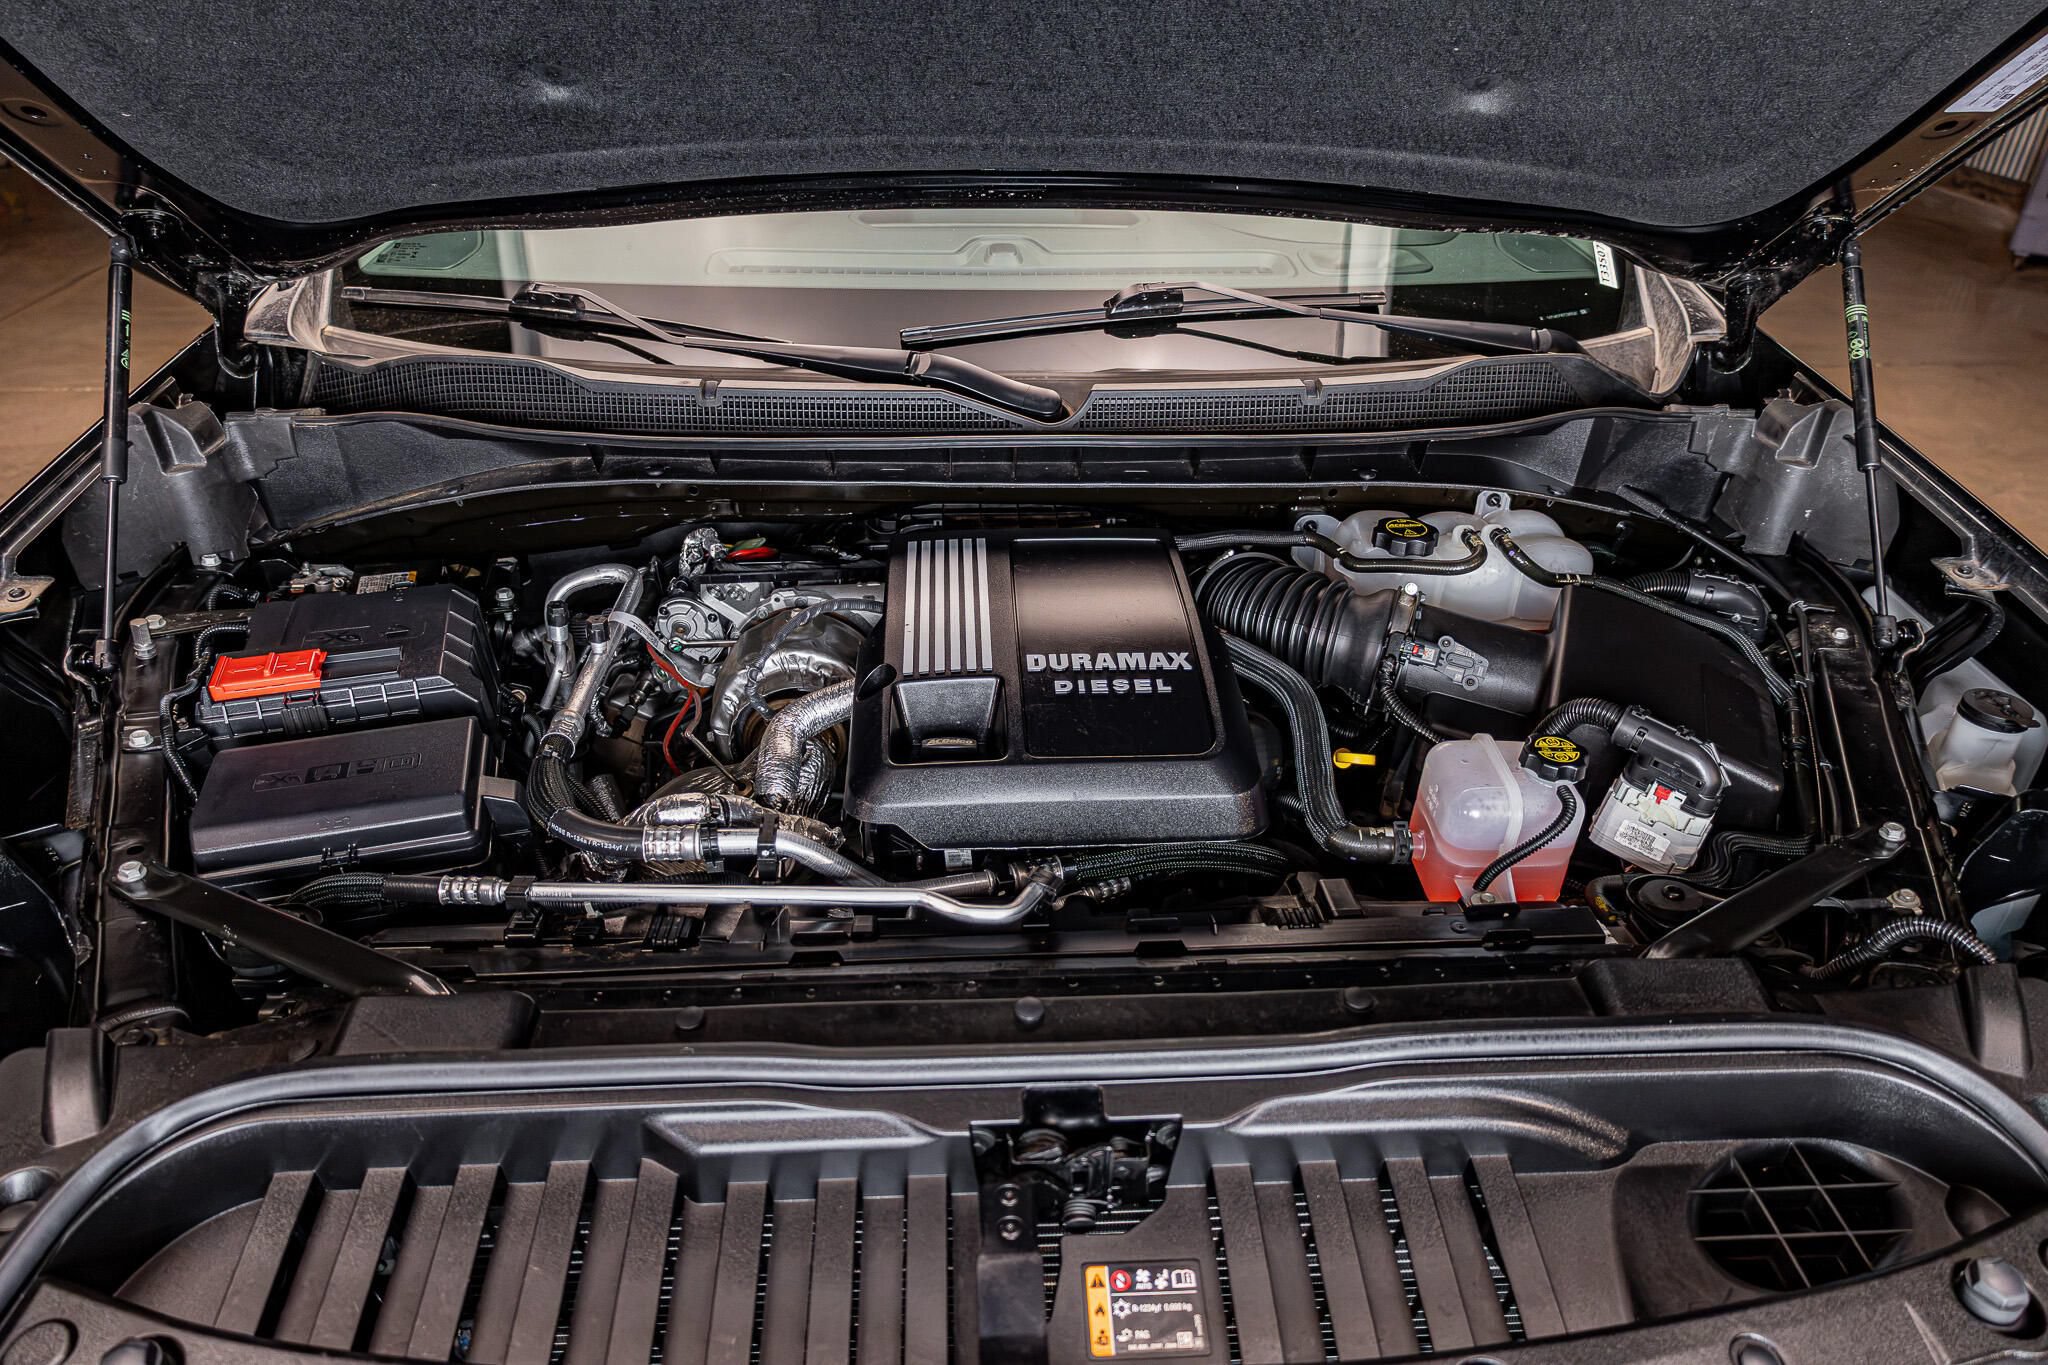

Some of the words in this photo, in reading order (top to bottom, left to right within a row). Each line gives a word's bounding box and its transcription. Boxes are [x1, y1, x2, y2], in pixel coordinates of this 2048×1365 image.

[1026, 652, 1192, 672] DURAMAX
[1054, 679, 1172, 694] DIESEL
[551, 822, 566, 835] HOSE
[592, 840, 623, 851] R-1234yf
